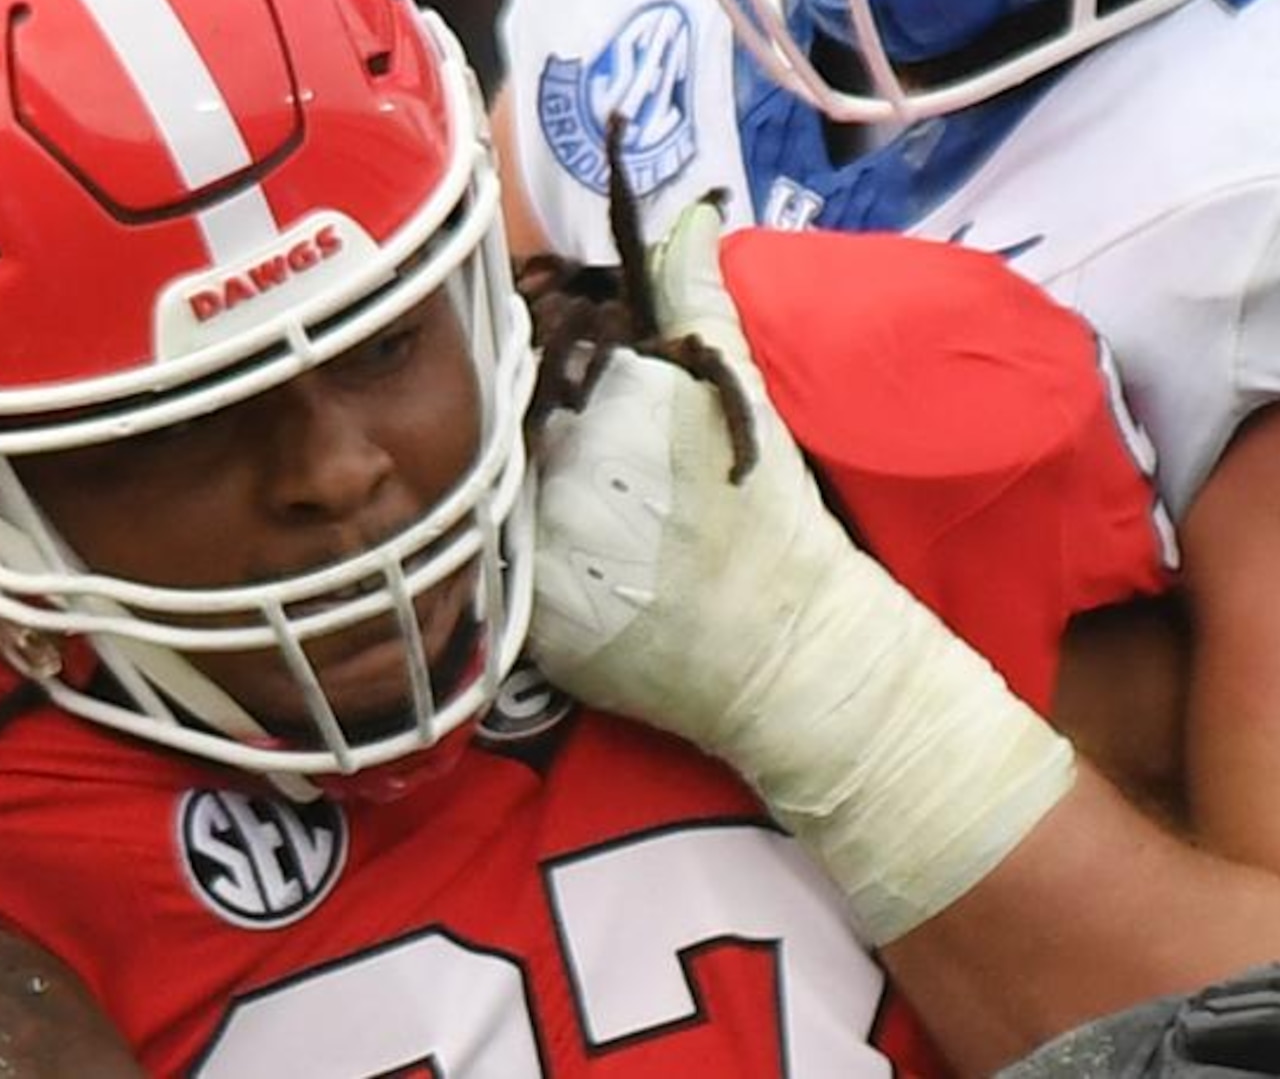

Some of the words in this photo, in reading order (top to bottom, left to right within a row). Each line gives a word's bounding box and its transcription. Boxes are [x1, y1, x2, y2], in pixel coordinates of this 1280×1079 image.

[588, 5, 690, 154] SEC
[542, 90, 670, 191] GRADUTE
[188, 225, 342, 323] DAWGS
